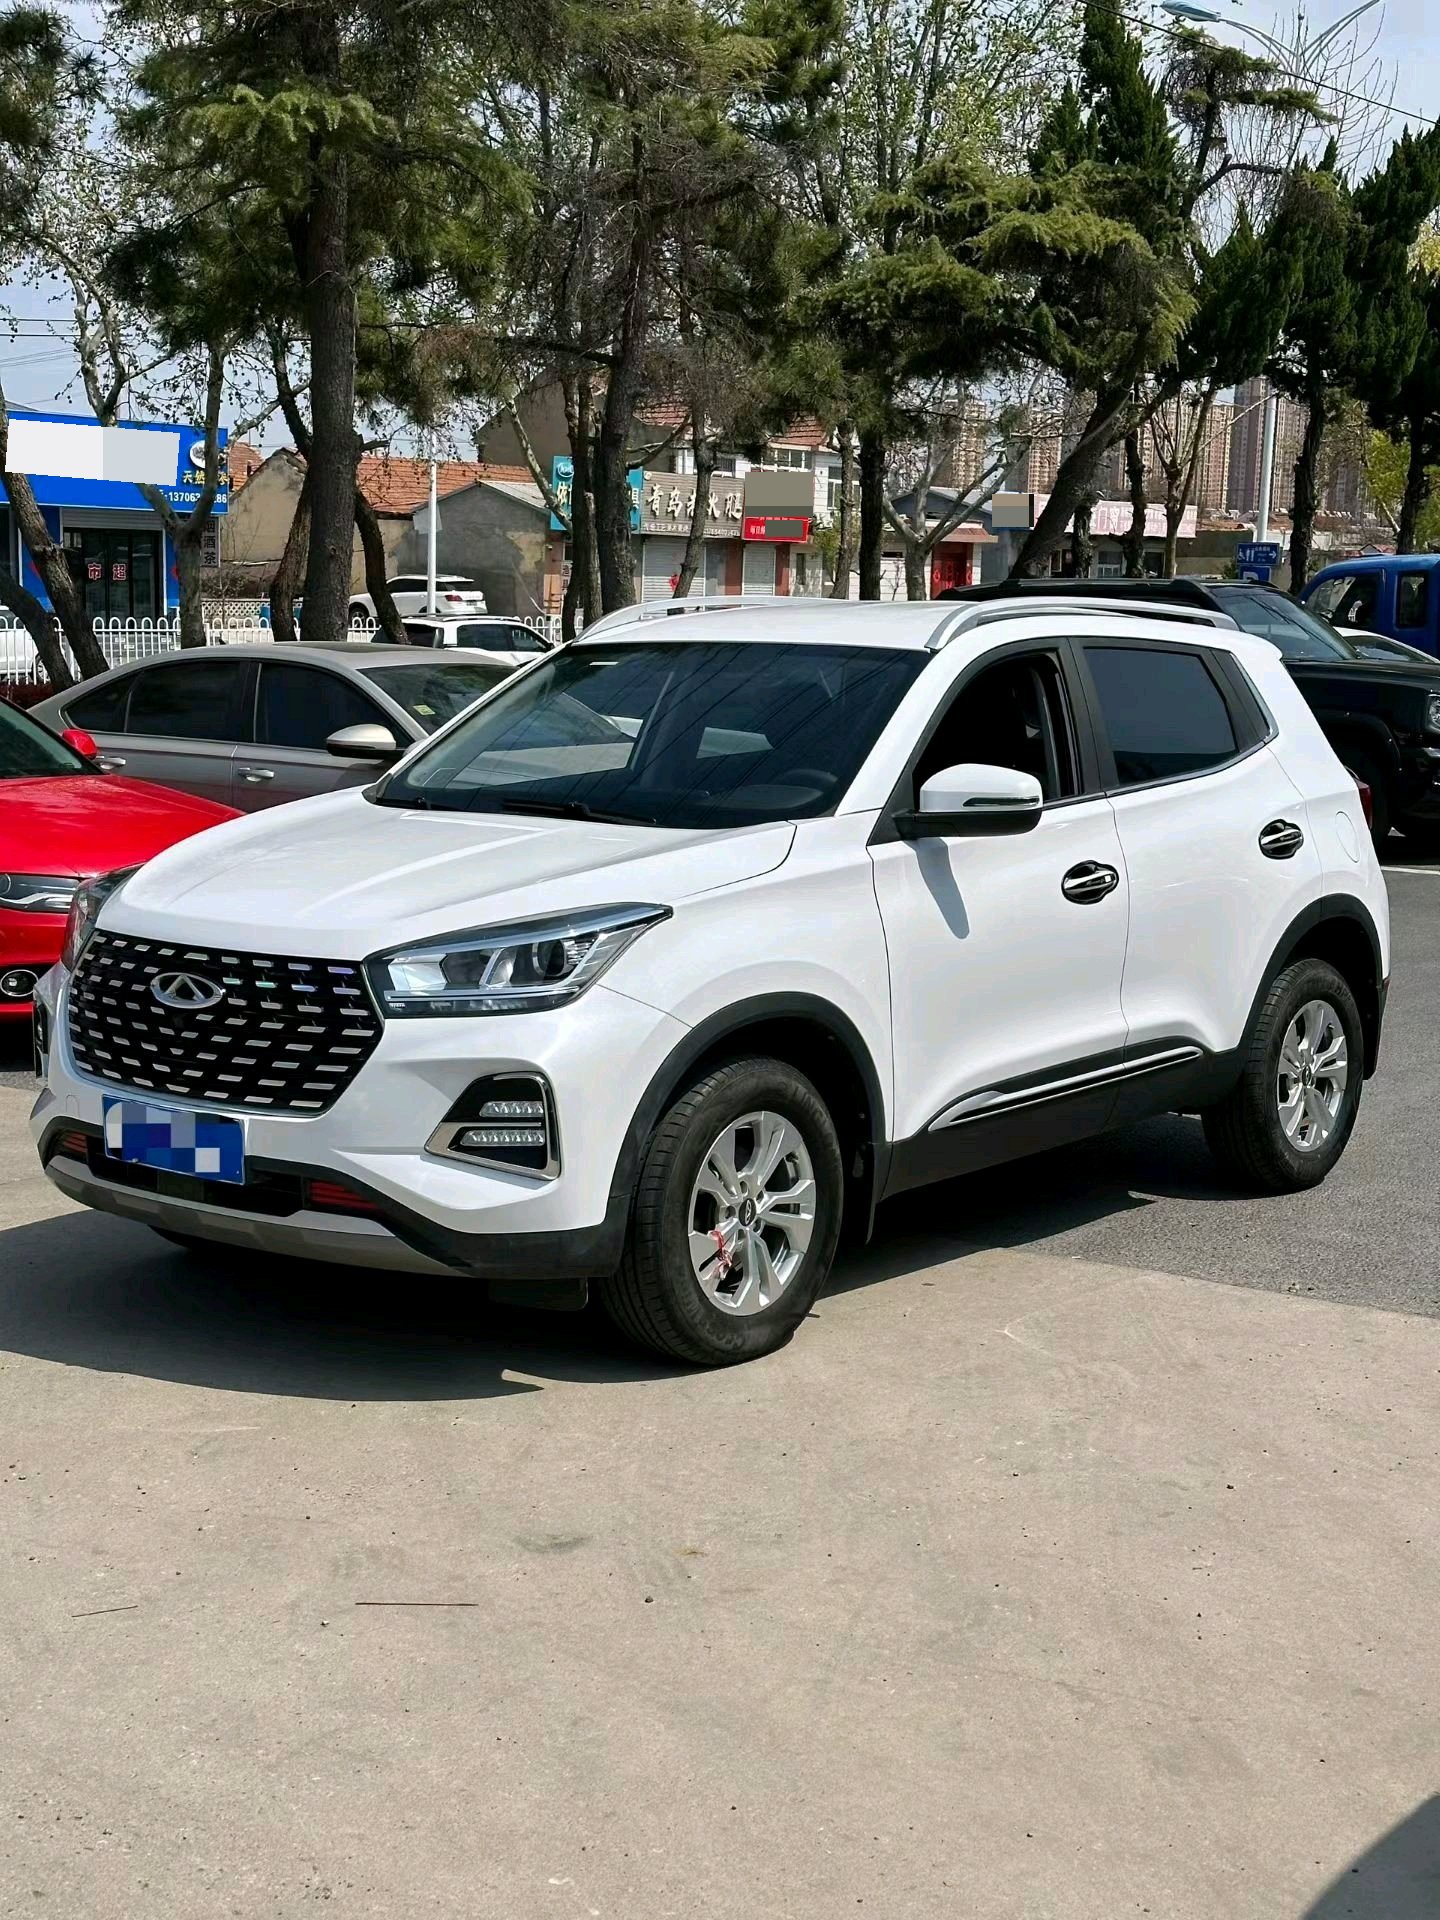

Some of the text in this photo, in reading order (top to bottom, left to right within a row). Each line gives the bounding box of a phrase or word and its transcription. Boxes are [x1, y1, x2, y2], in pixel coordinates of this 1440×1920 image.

[168, 491, 227, 504] 13706386
[87, 562, 126, 581] 市 超
